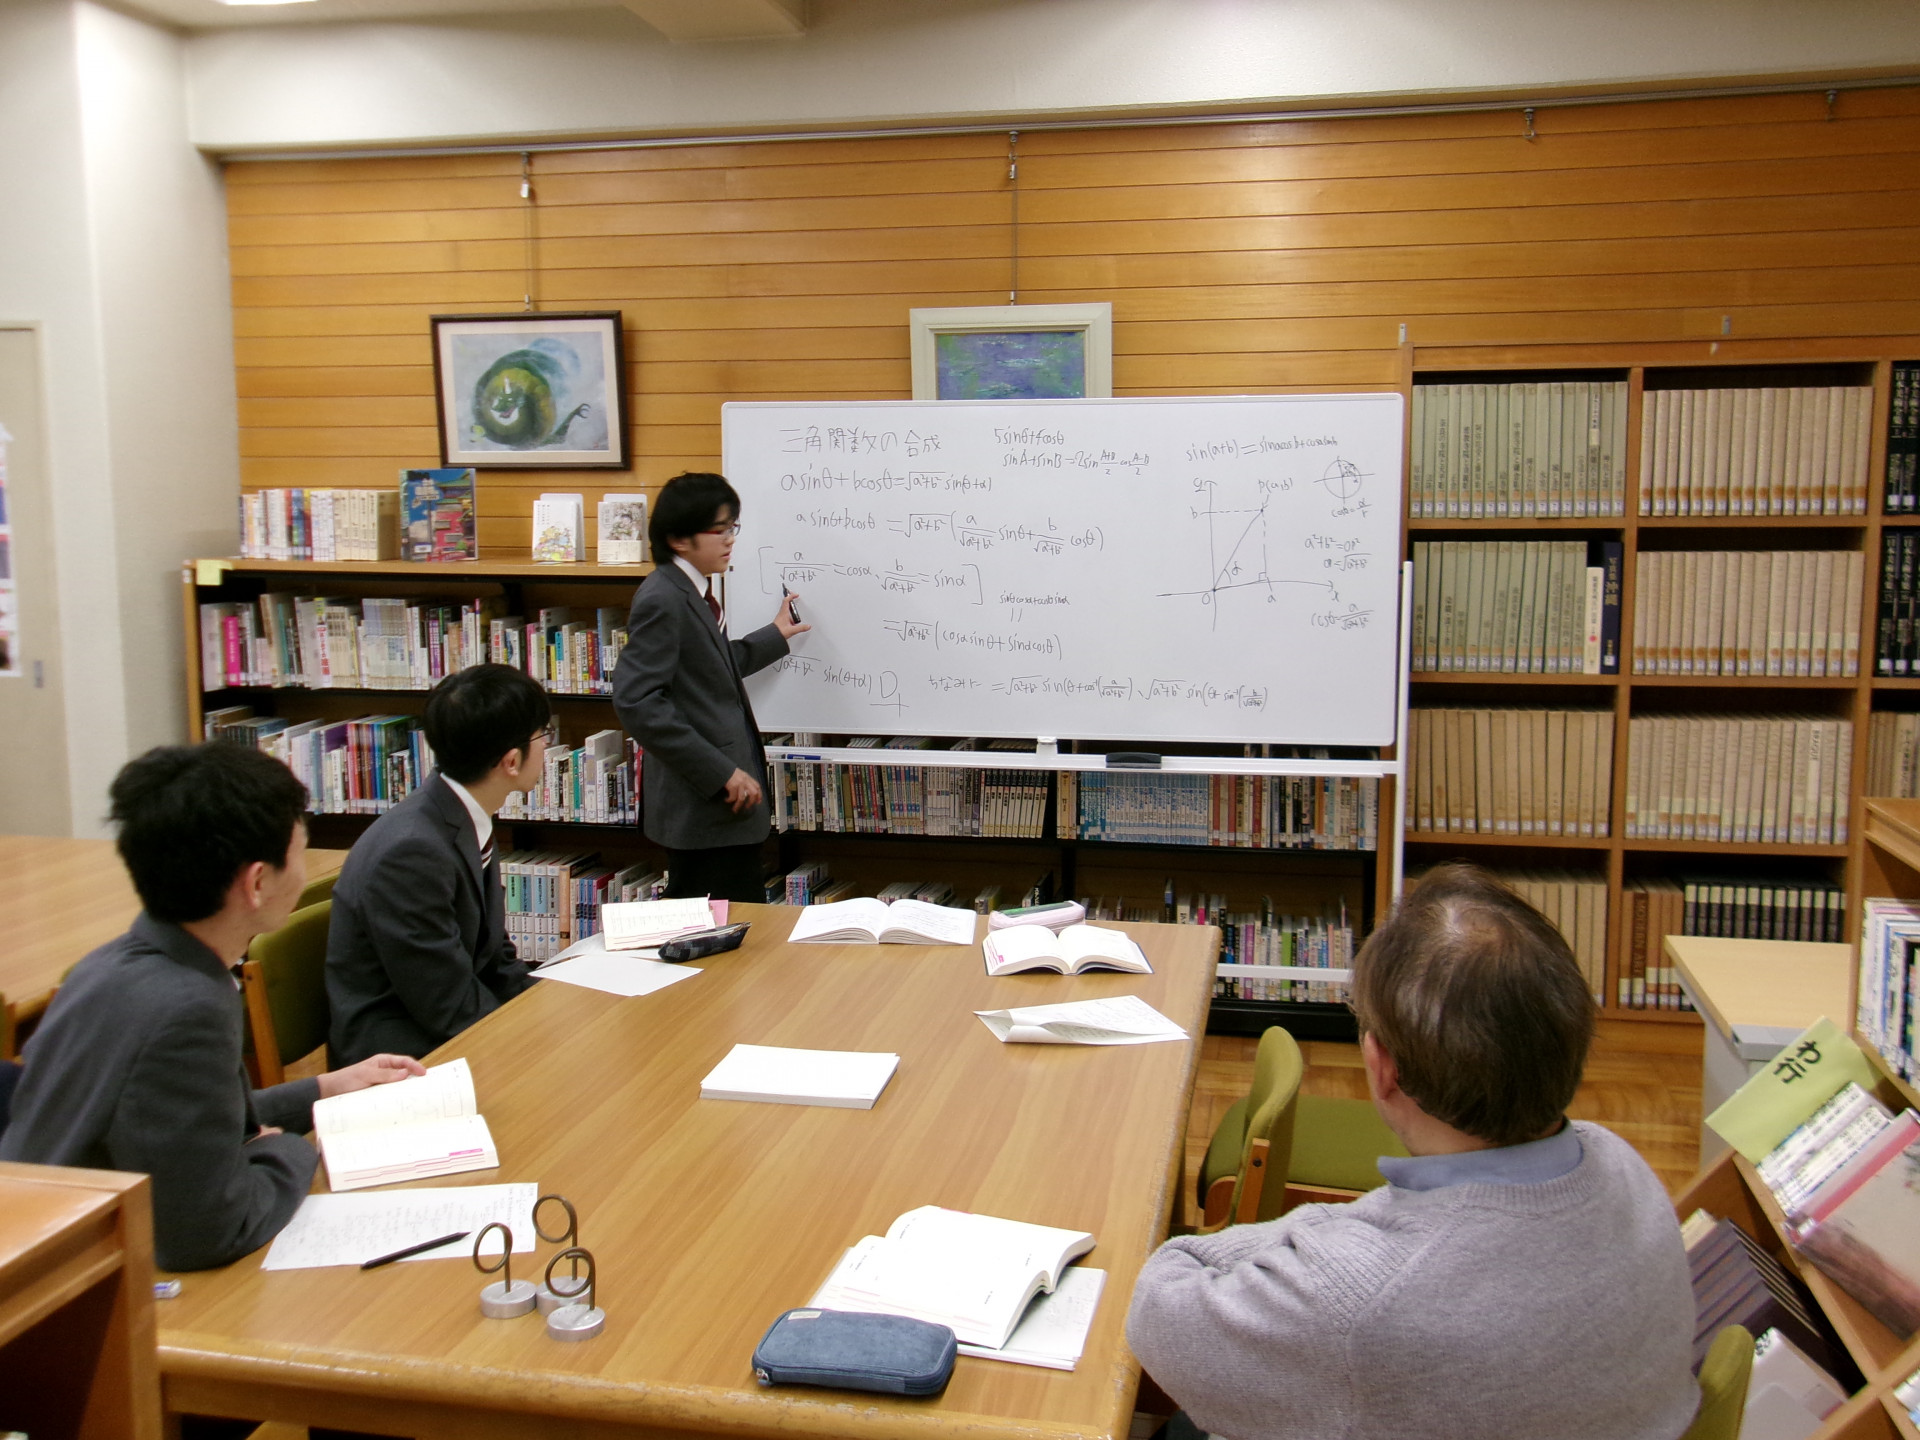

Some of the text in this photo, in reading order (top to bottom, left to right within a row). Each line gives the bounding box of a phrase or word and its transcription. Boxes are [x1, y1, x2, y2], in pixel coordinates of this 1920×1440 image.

[779, 425, 942, 458] 三角関数の合成
[1773, 1040, 1822, 1085] わ行
